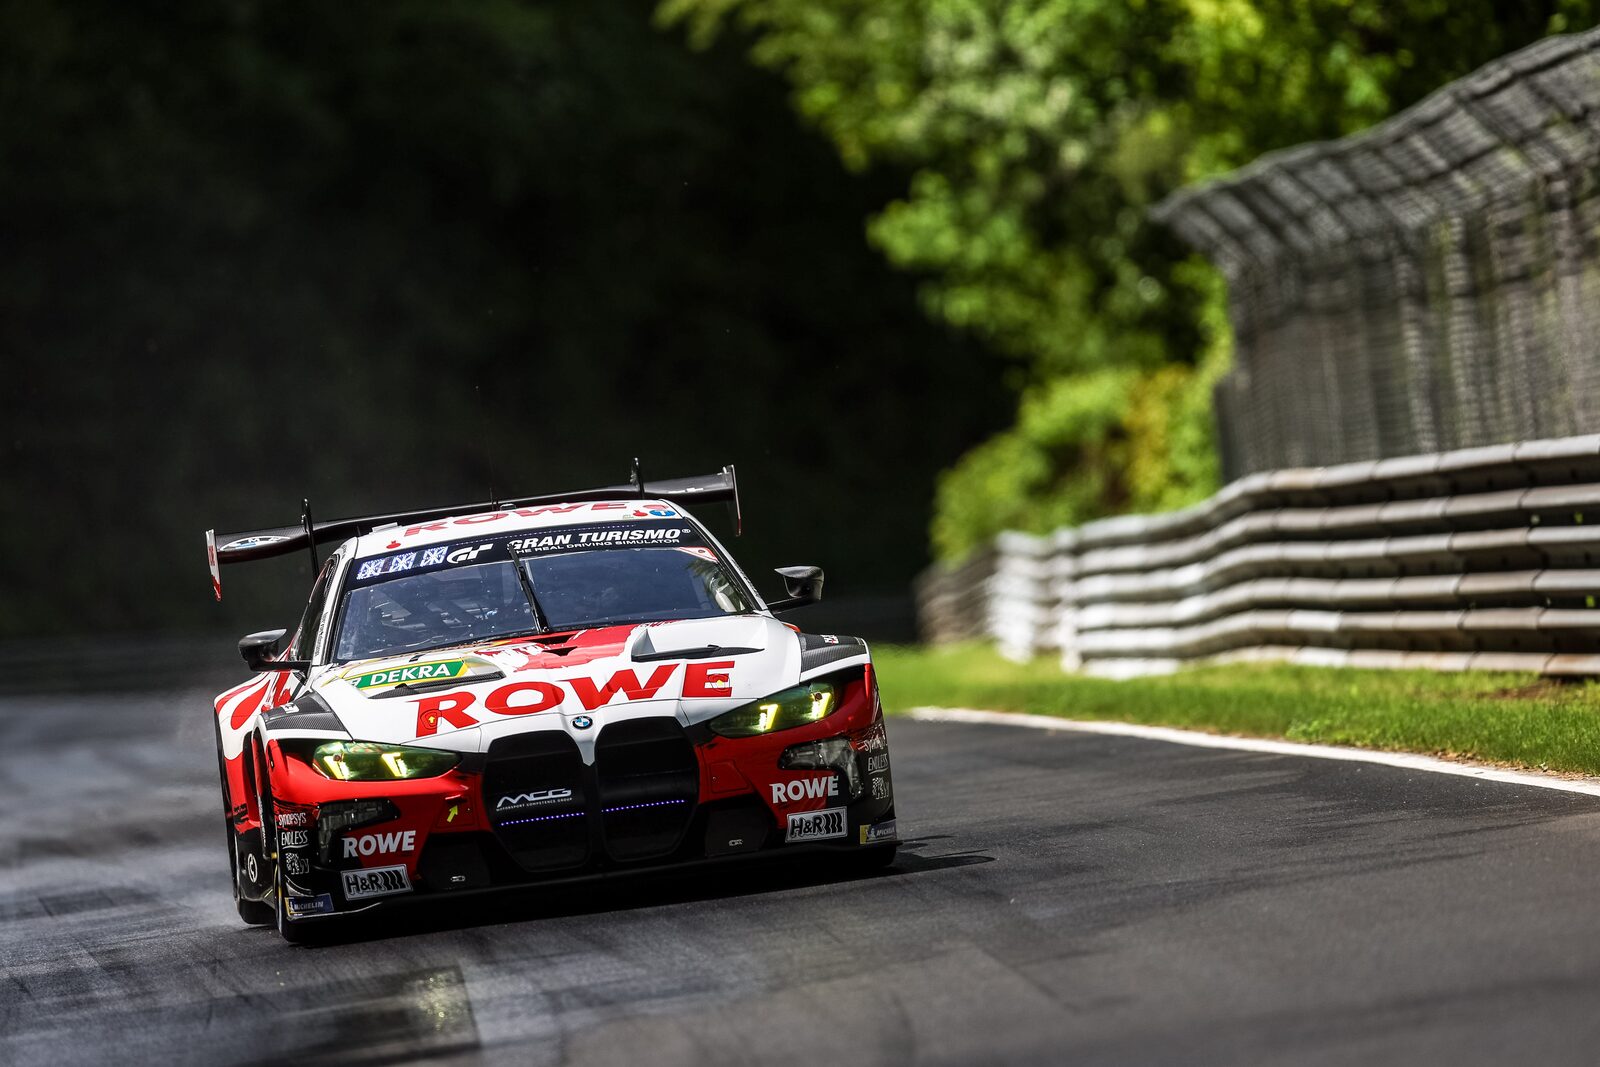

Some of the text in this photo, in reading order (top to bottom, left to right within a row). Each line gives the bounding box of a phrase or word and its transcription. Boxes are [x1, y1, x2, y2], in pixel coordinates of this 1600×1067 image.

[404, 502, 627, 537] ROWE
[508, 534, 572, 550] GRAN
[566, 540, 612, 549] DRIVING
[615, 538, 680, 546] SIMULATOR
[370, 664, 451, 686] DEKRA
[406, 660, 735, 738] ROWE
[769, 775, 839, 803] ROWE
[281, 830, 308, 846] ENDLESS
[341, 830, 416, 858] ROWE
[293, 901, 324, 910] MICHELIN
